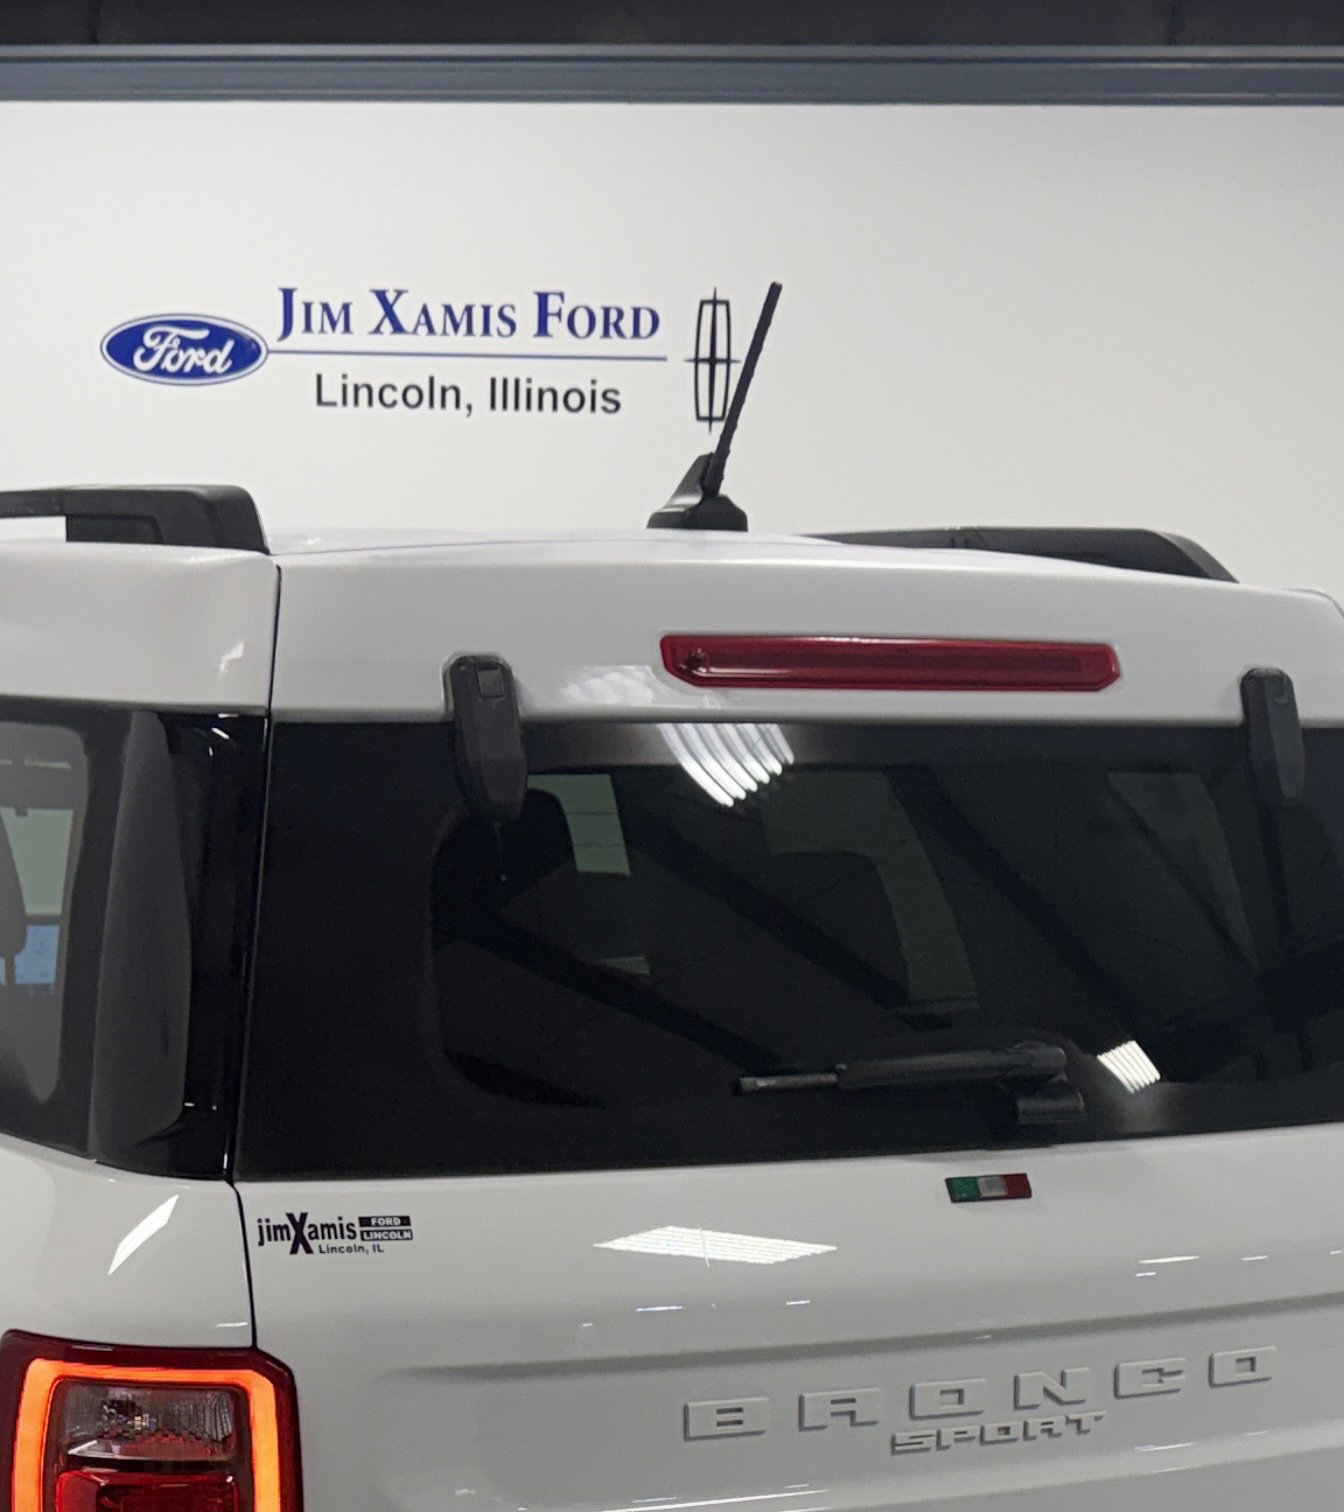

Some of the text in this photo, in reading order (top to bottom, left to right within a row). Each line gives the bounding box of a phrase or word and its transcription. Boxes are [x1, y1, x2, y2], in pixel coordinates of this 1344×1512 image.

[277, 286, 661, 343] JIM XAMIS FORD
[133, 325, 233, 375] Ford
[315, 372, 622, 418] Lincoln, Illinois
[362, 1230, 412, 1241] LINCOLN
[370, 1217, 402, 1227] FORD
[318, 1244, 385, 1255] Lincoln, IL
[683, 1346, 1277, 1441] BRONCO
[890, 1410, 1106, 1455] SPORT
